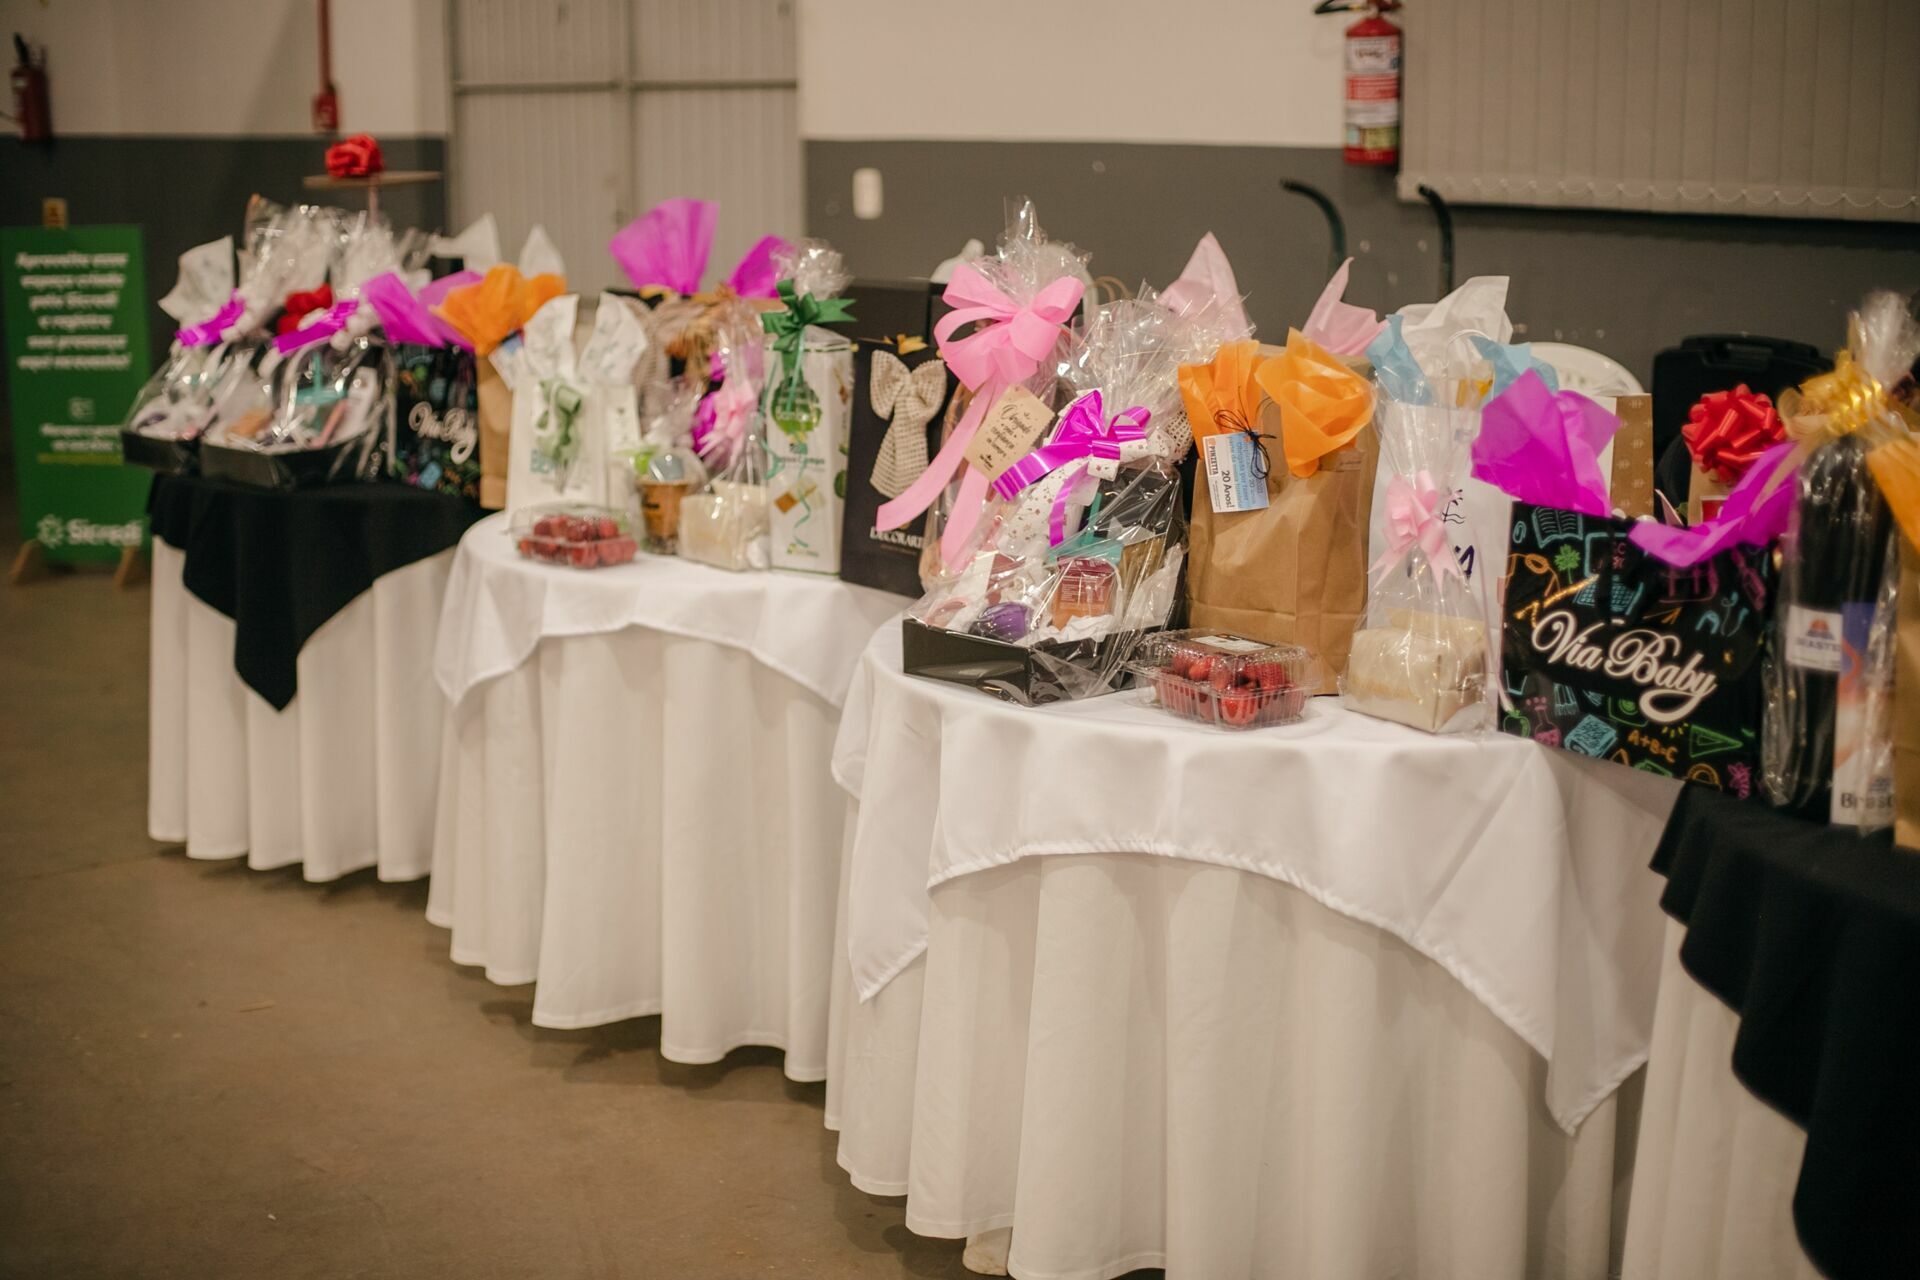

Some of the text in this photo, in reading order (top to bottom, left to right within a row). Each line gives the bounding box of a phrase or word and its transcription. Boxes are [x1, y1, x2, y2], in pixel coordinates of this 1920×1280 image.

[1208, 445, 1219, 475] PINZETTA
[1221, 470, 1234, 507] 20 Anos!
[1532, 610, 1718, 723] Via Baby
